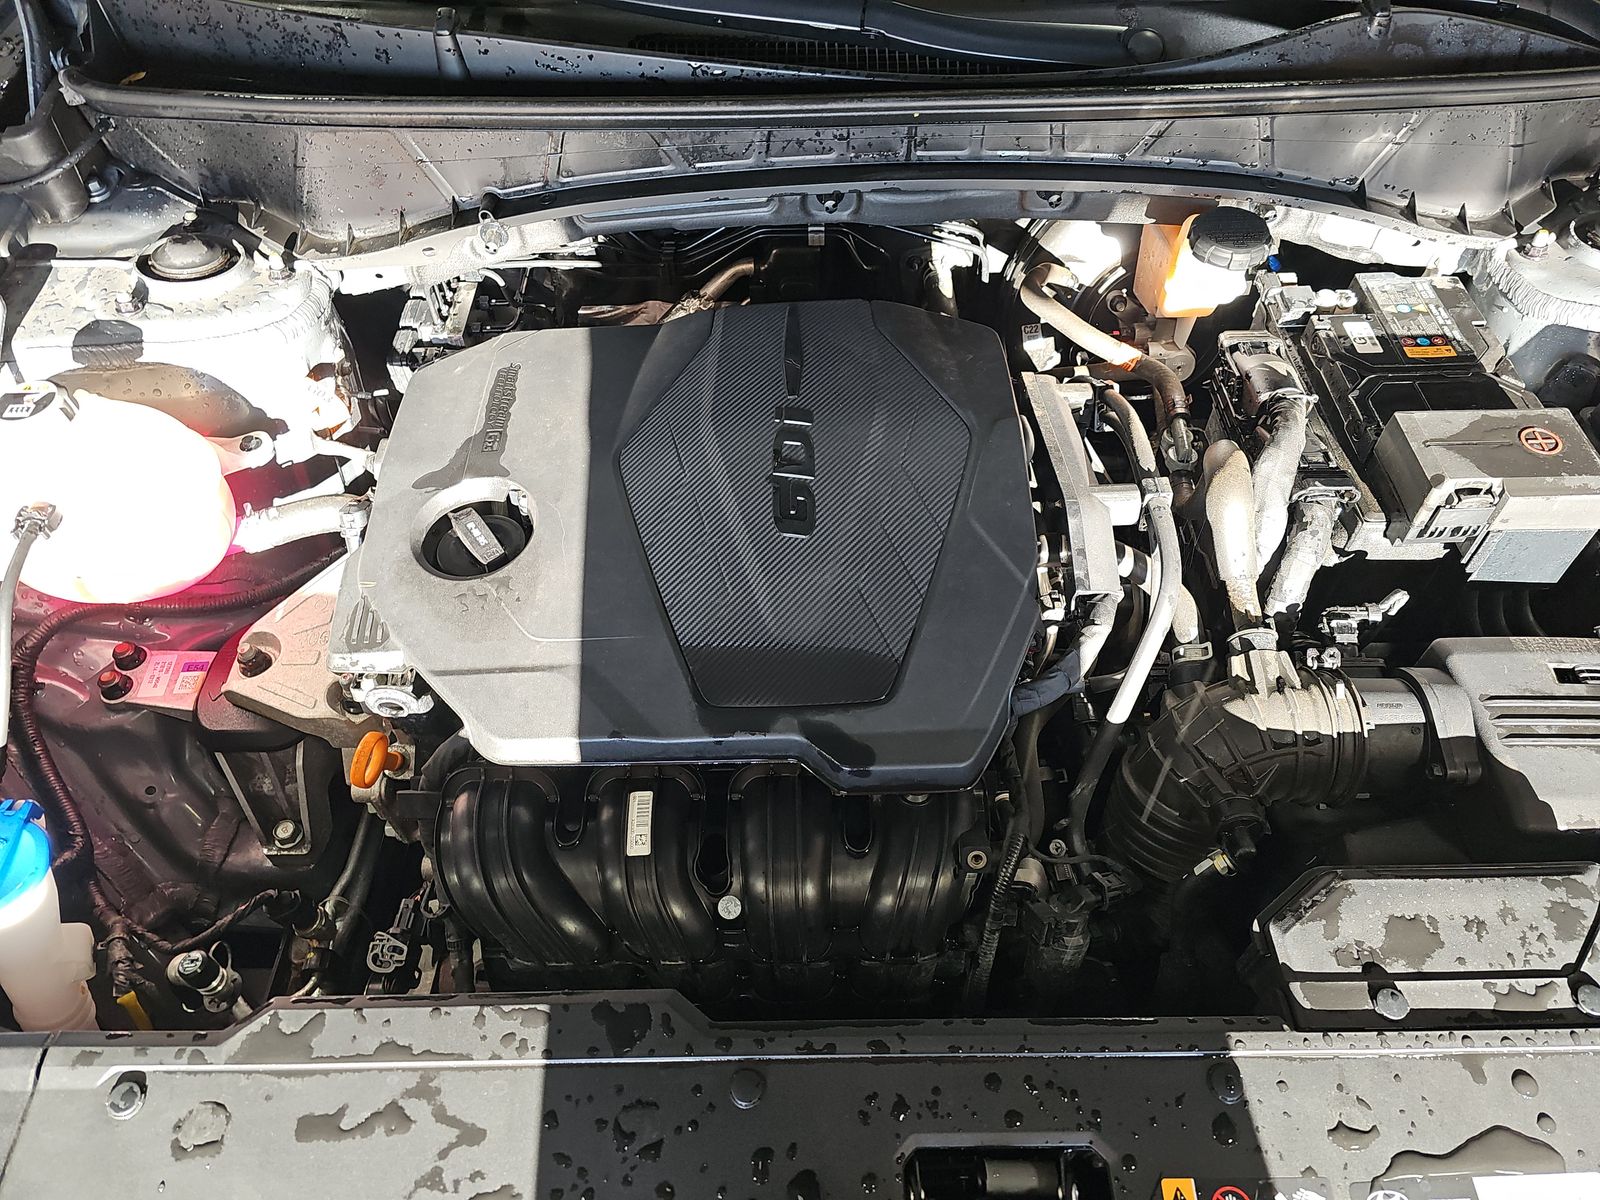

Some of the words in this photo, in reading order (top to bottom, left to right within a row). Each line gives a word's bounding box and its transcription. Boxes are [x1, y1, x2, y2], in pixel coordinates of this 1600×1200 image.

[1023, 324, 1039, 335] C22
[487, 368, 508, 429] TECHNOLOGY
[187, 664, 205, 672] E54
